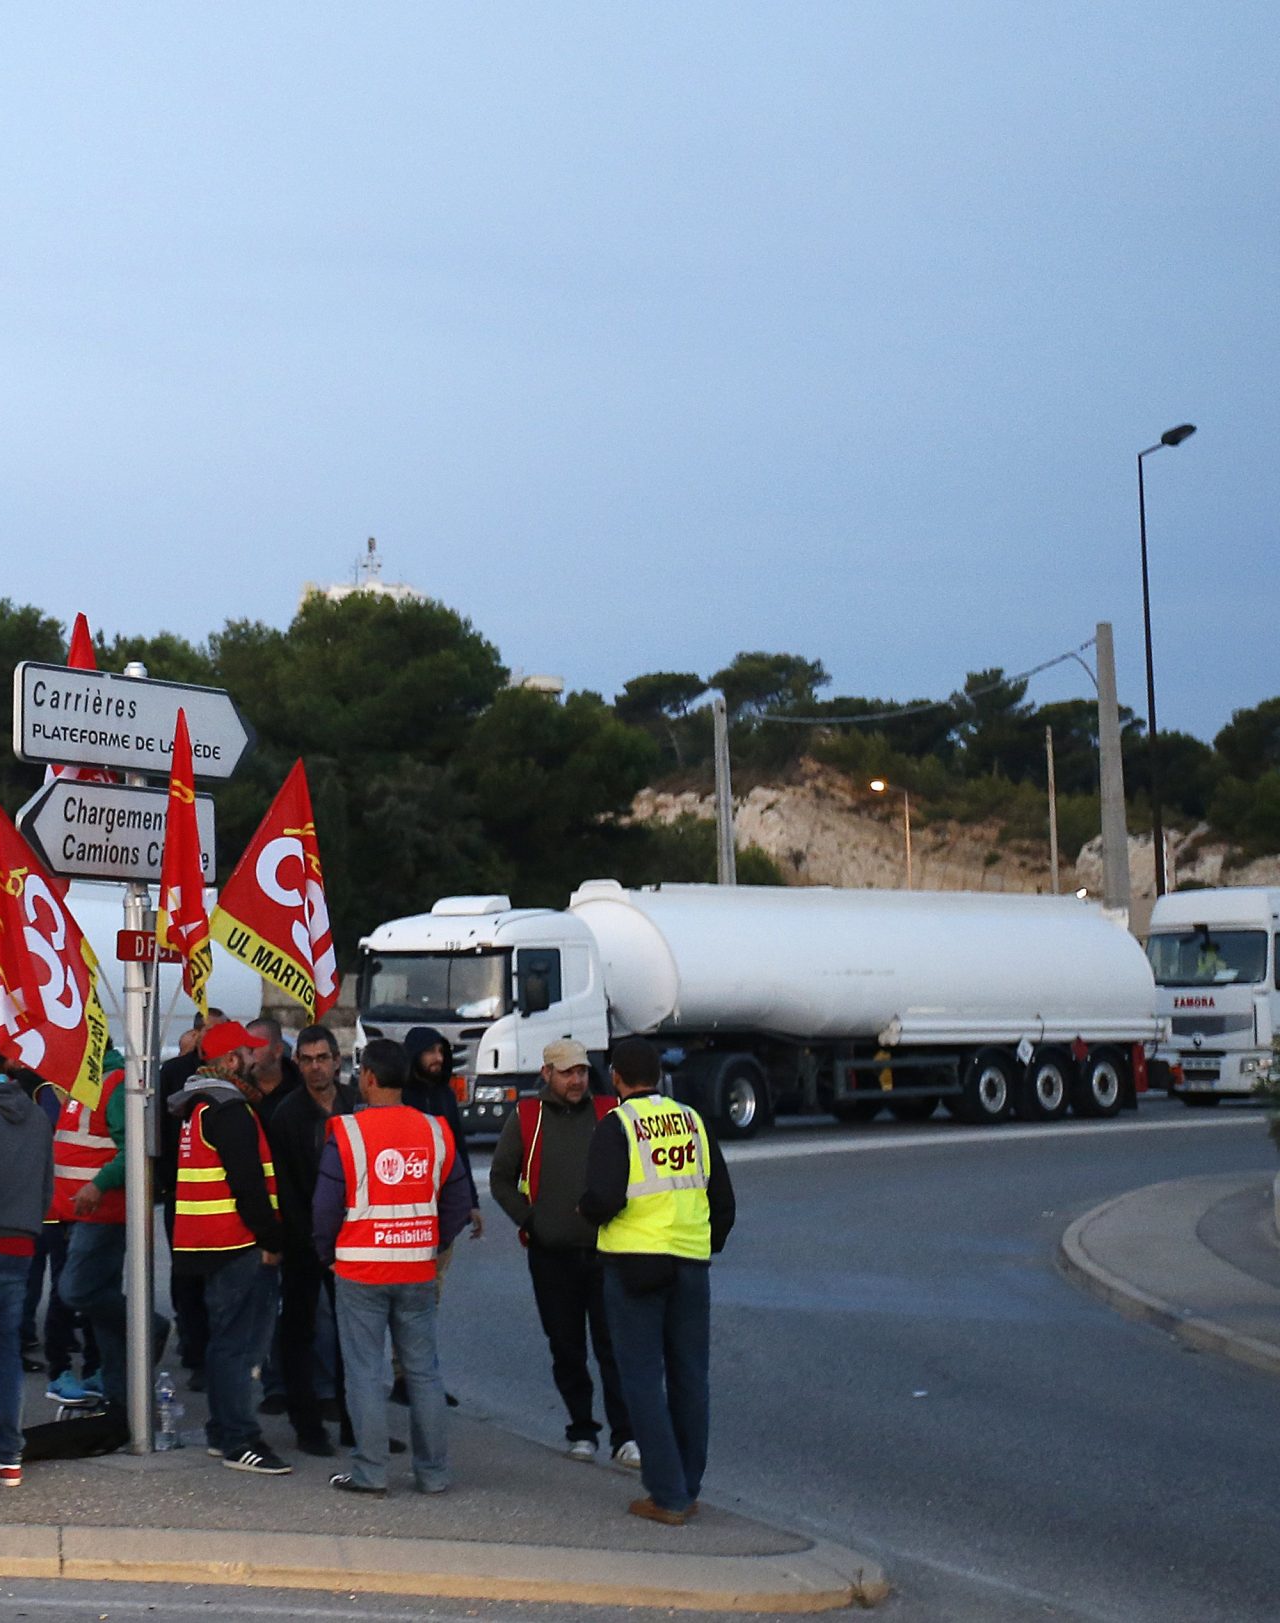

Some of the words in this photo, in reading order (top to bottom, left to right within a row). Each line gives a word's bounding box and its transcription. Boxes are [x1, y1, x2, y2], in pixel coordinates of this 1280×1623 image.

[33, 681, 137, 719] Carrières
[32, 723, 130, 749] PLATEFORME
[135, 736, 154, 752] DE
[192, 739, 221, 760] ÈDE
[63, 796, 167, 833] Chargemen
[62, 834, 140, 866] Camions
[227, 927, 251, 958] UL
[633, 1112, 699, 1142] ASCOMETAL
[405, 1152, 429, 1179] cgt
[651, 1140, 696, 1171] cgt
[374, 1227, 433, 1245] Pénibilité
